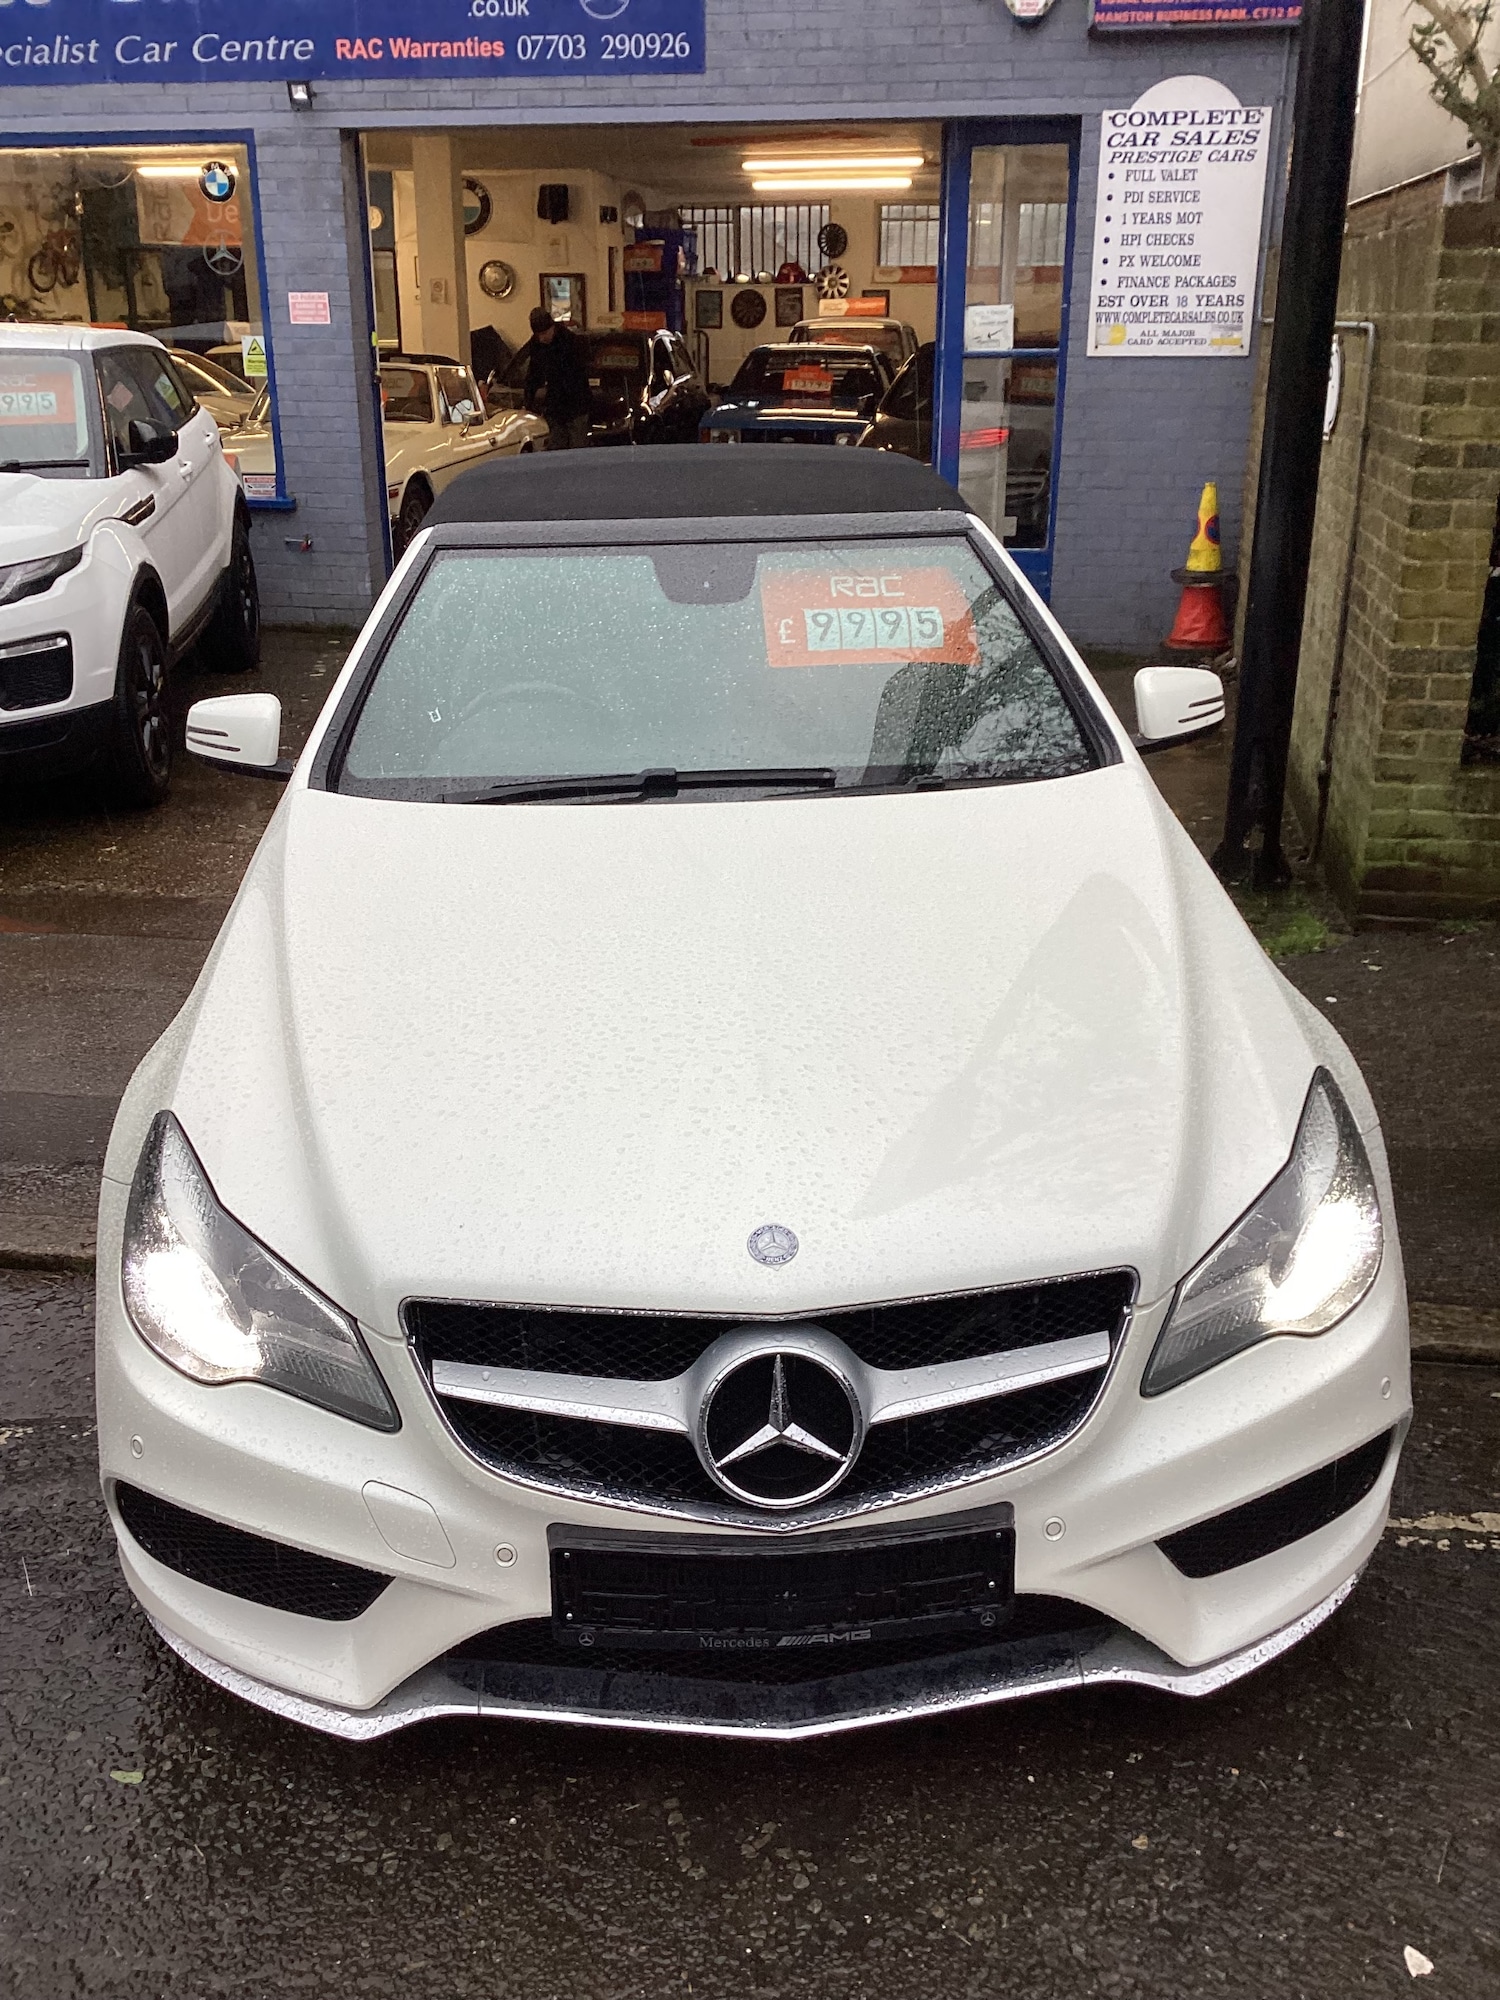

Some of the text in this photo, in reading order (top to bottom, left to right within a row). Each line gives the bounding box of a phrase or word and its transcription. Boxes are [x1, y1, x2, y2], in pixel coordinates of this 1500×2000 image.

[0, 32, 690, 65] cialist Car Centre RAC Warranties 07703 290926
[1111, 109, 1262, 127] COMPLETE
[1107, 129, 1260, 148] CAR SALES
[1108, 149, 1258, 164] PRESTIGE CARS
[1125, 168, 1198, 182] FULL VALET
[1123, 190, 1200, 204] PDI SERVICE
[1122, 211, 1203, 225] 1 YEARS MOT
[1120, 233, 1195, 246] HPI CHECKS
[1118, 254, 1201, 267] PX WELCOME
[1117, 275, 1237, 288] FINANCE PACKAGES
[1097, 294, 1245, 307] EST OVER 18 YEARS
[1127, 338, 1154, 346] CARD
[699, 1629, 871, 1648] Mercedes AMG
